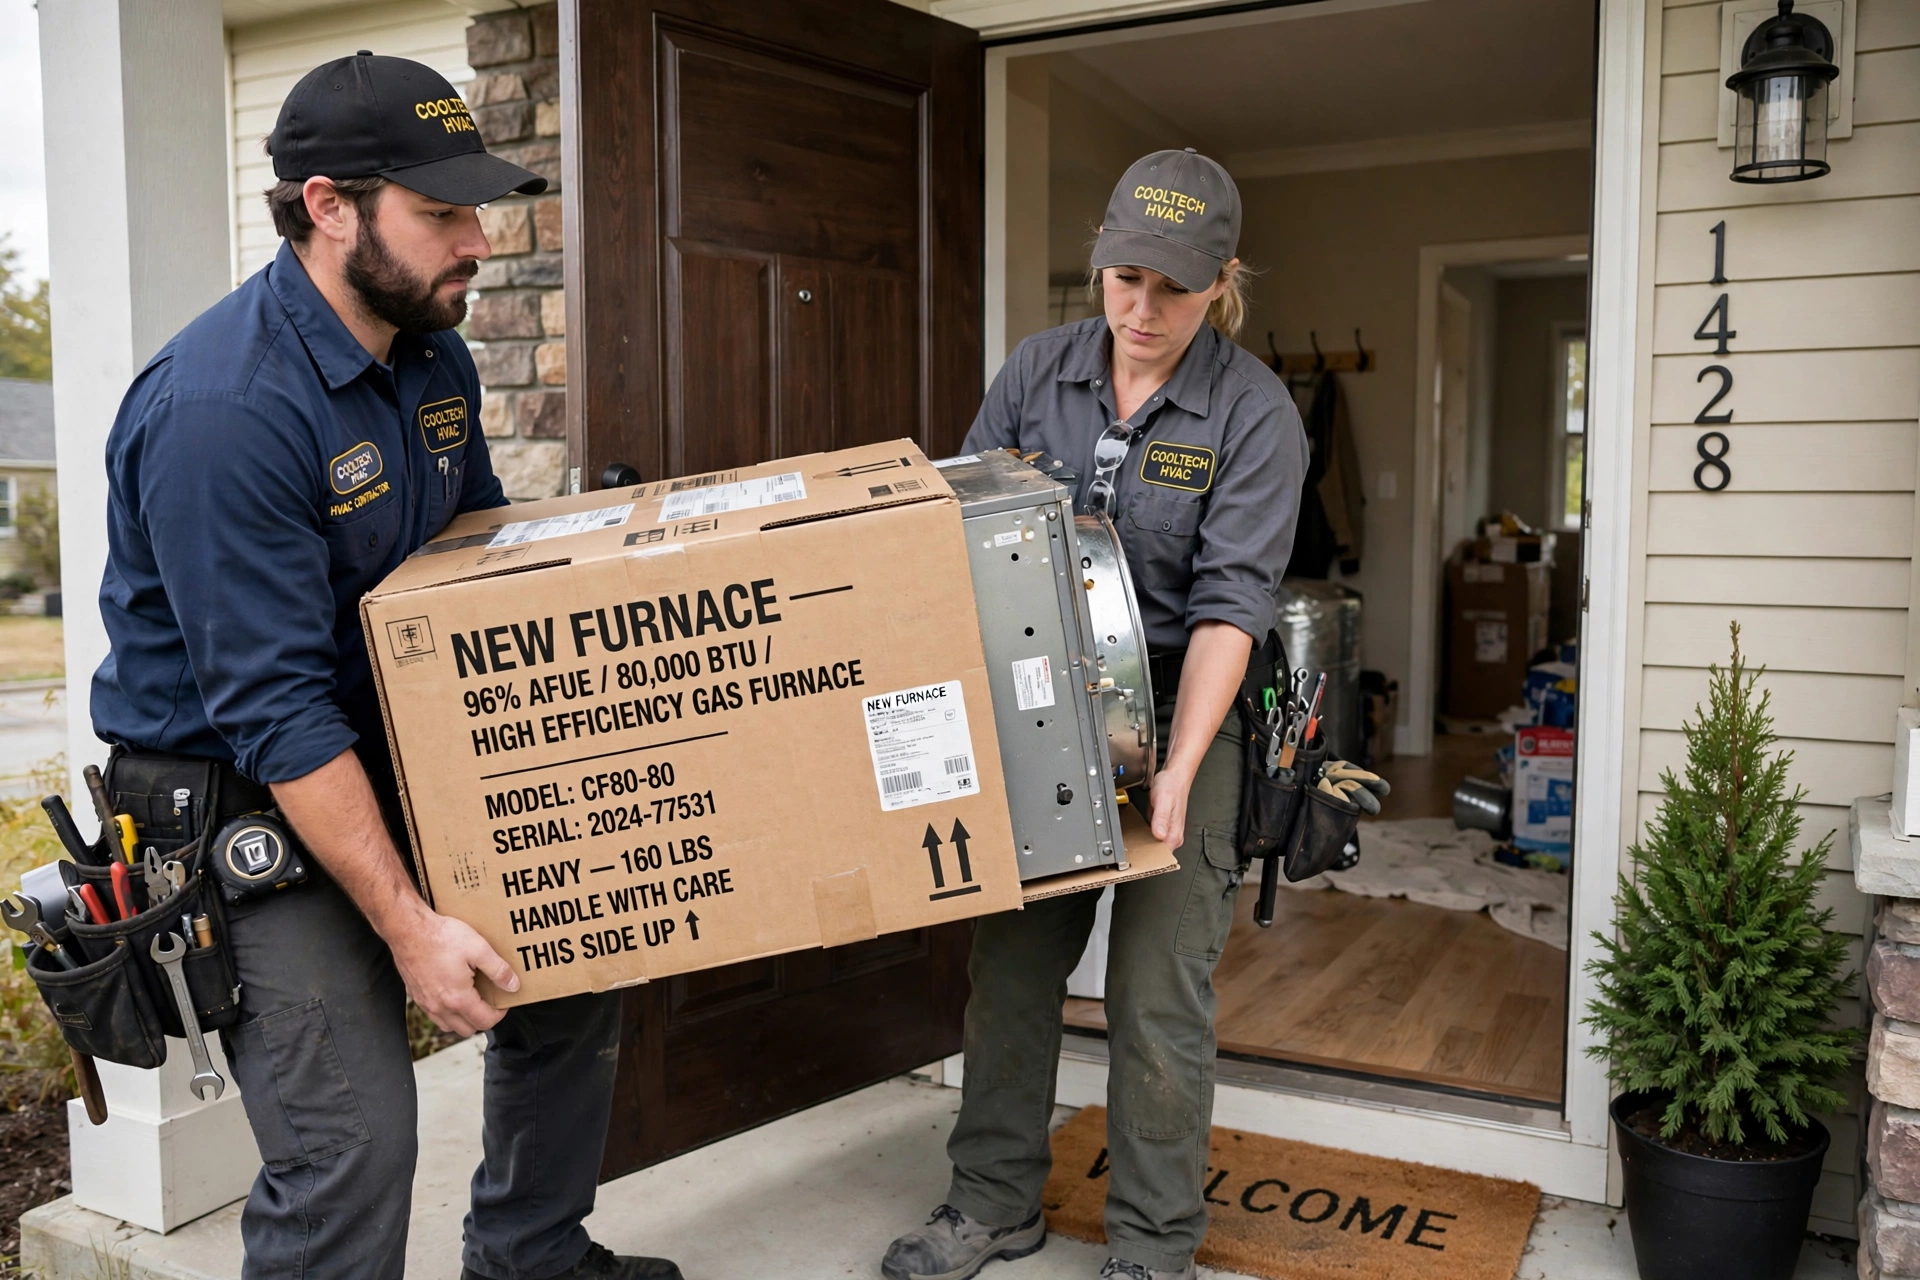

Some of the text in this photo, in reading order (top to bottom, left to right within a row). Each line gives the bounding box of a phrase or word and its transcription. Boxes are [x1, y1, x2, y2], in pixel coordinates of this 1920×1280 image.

[415, 97, 469, 119] COOLTE
[442, 116, 475, 134] HVAC
[1134, 185, 1206, 215] COOLTECH
[1144, 203, 1186, 223] HVAC
[423, 406, 465, 428] COOLTECH
[436, 424, 460, 441] HVAC
[1151, 449, 1209, 470] COOLTECH
[1160, 465, 1192, 480] HVAC
[330, 500, 353, 516] HVAC
[450, 616, 555, 679] NEW
[569, 577, 782, 658] FURNACE
[463, 682, 522, 718] 96%
[529, 669, 594, 707] AFUE
[616, 650, 701, 690] 80,000
[706, 639, 757, 674] BTU
[471, 659, 865, 757] HIGH EFFICIENCY GAS FURNACE
[867, 686, 947, 712] NEW FURNACE
[484, 761, 675, 820] MODEL: CF80-80
[492, 789, 716, 855] SERIAL: 2024-77531
[501, 858, 581, 898] HEAVY
[620, 844, 662, 875] 160
[667, 834, 713, 867] LBS
[509, 868, 734, 935] HANDLE WITH CARE
[516, 918, 676, 972] THIS SIDE UP
[1086, 1147, 1458, 1252] LCOME
